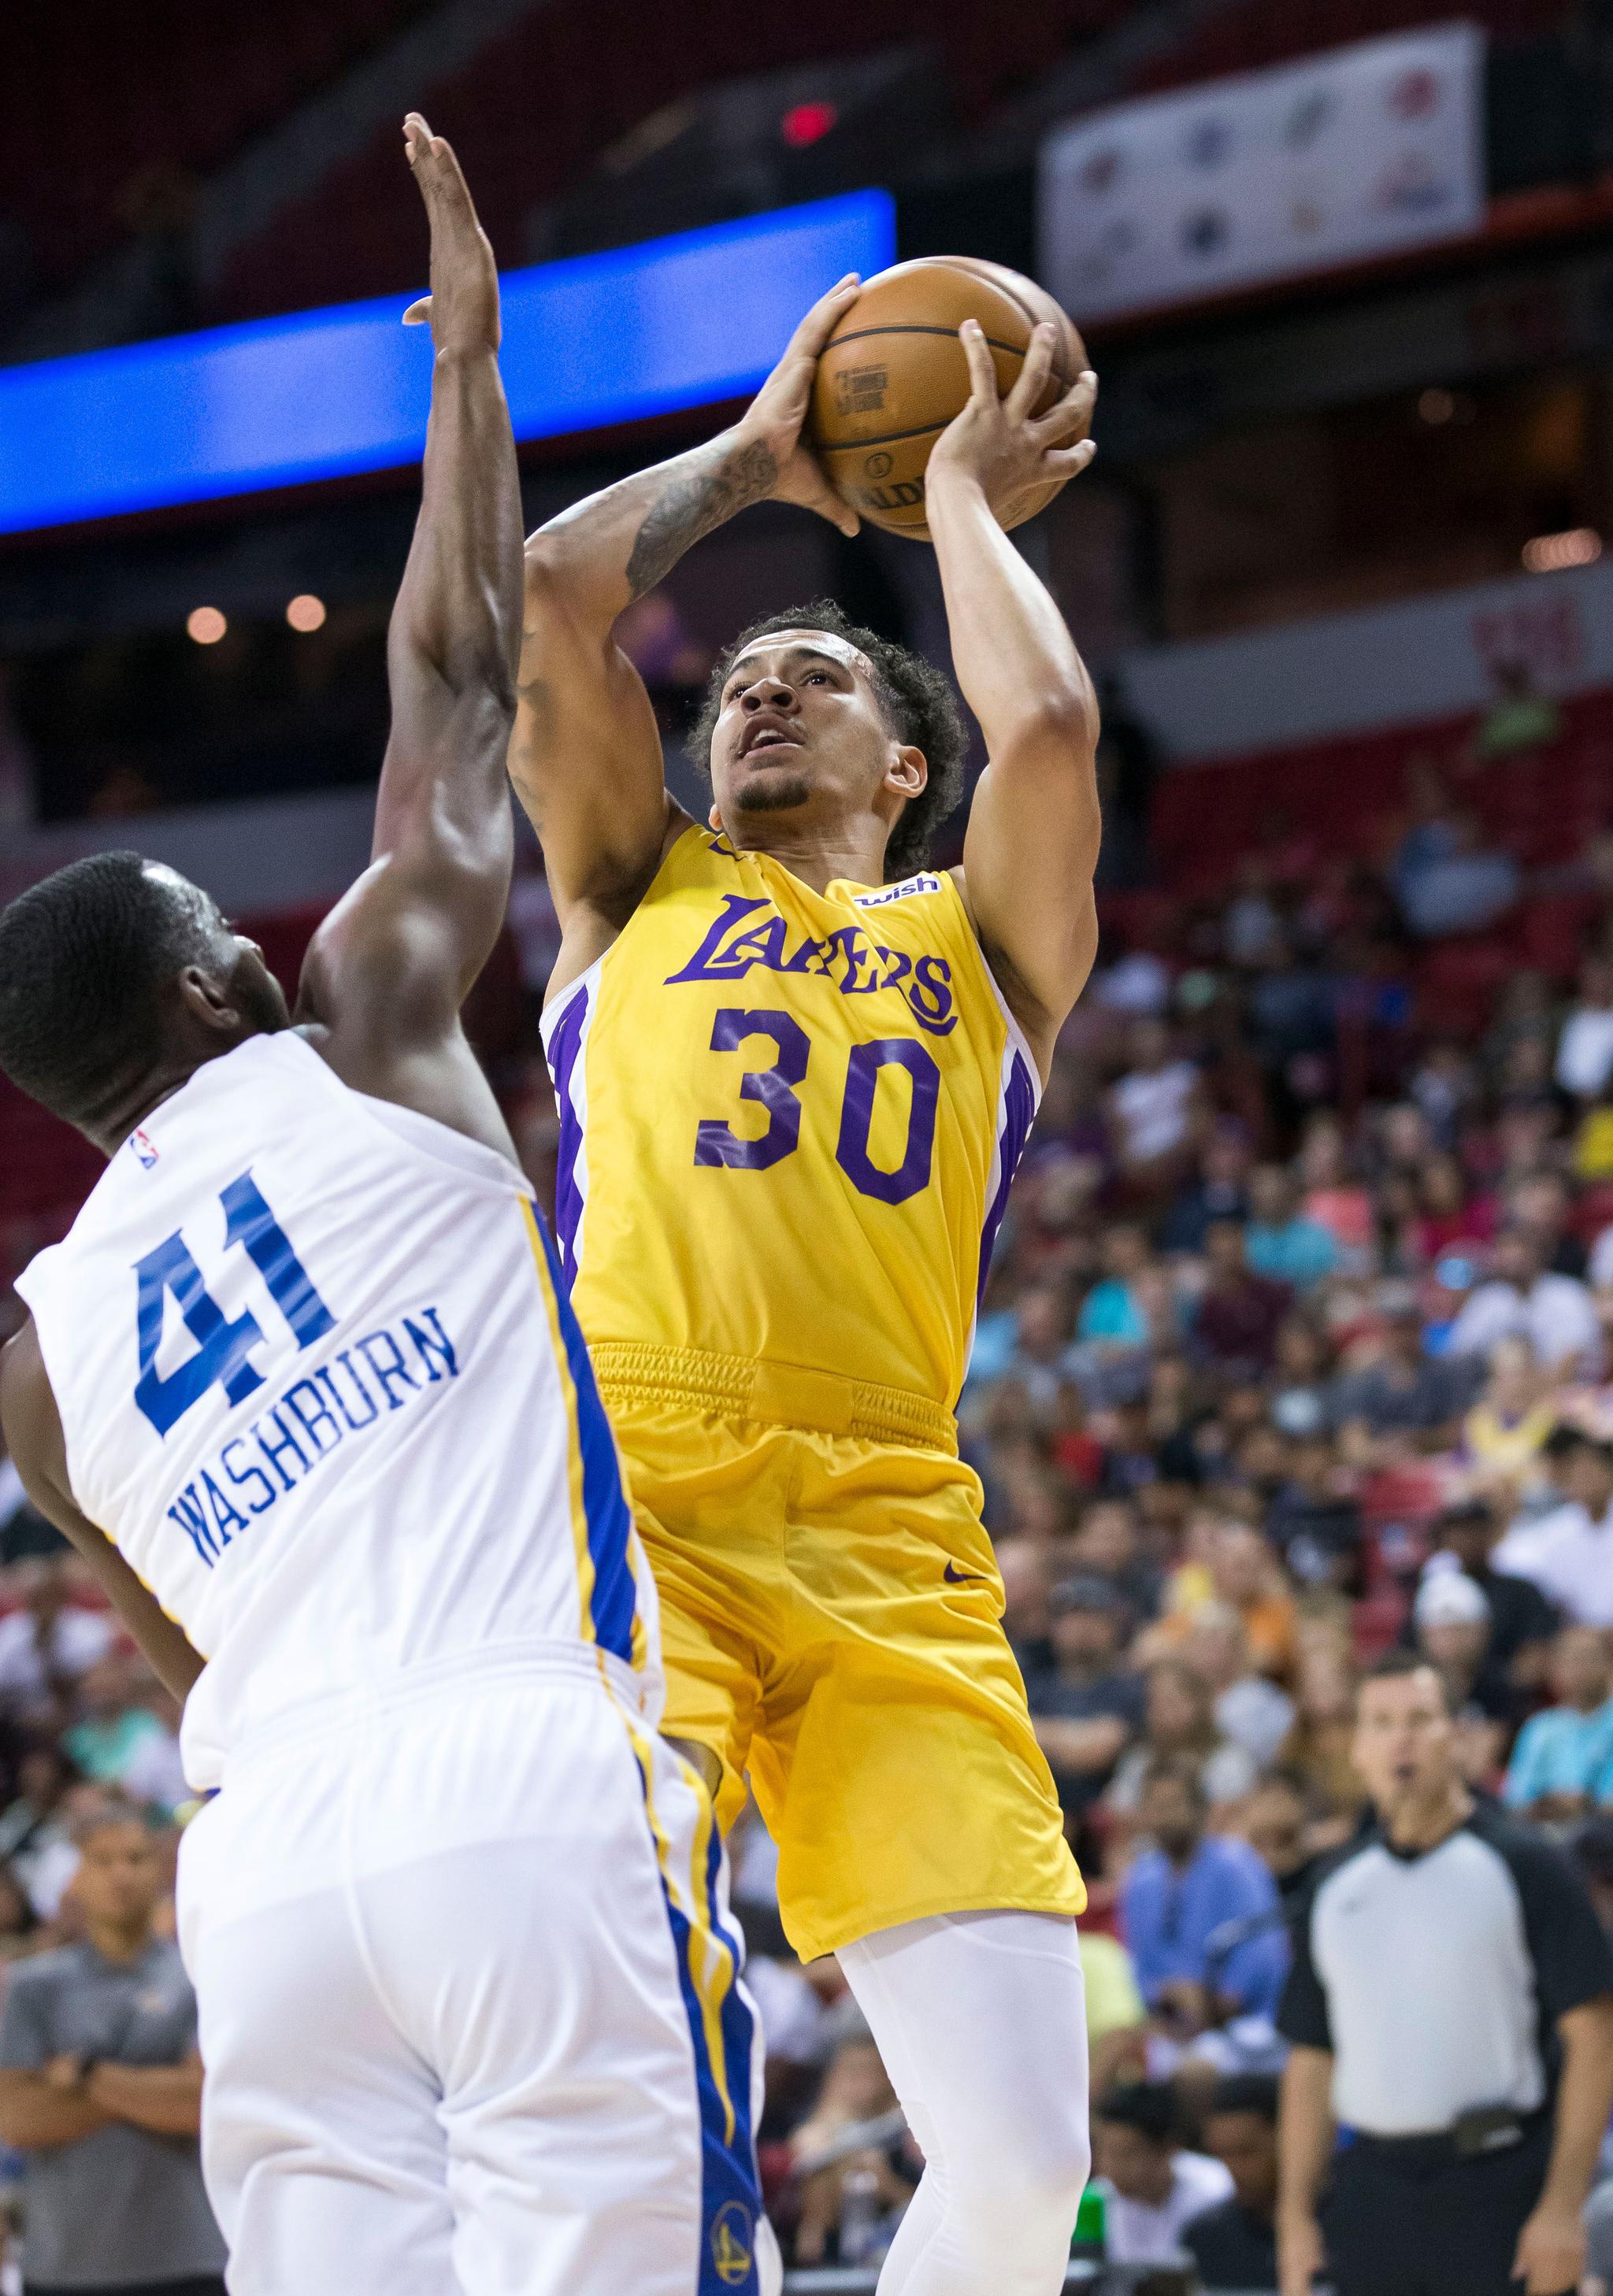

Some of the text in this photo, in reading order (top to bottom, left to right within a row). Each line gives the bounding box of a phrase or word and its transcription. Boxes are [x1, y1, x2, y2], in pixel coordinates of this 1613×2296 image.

[853, 877, 938, 906] wish
[693, 1008, 941, 1206] 30
[131, 1165, 340, 1442] 41
[166, 1307, 460, 1569] WASHBURN
